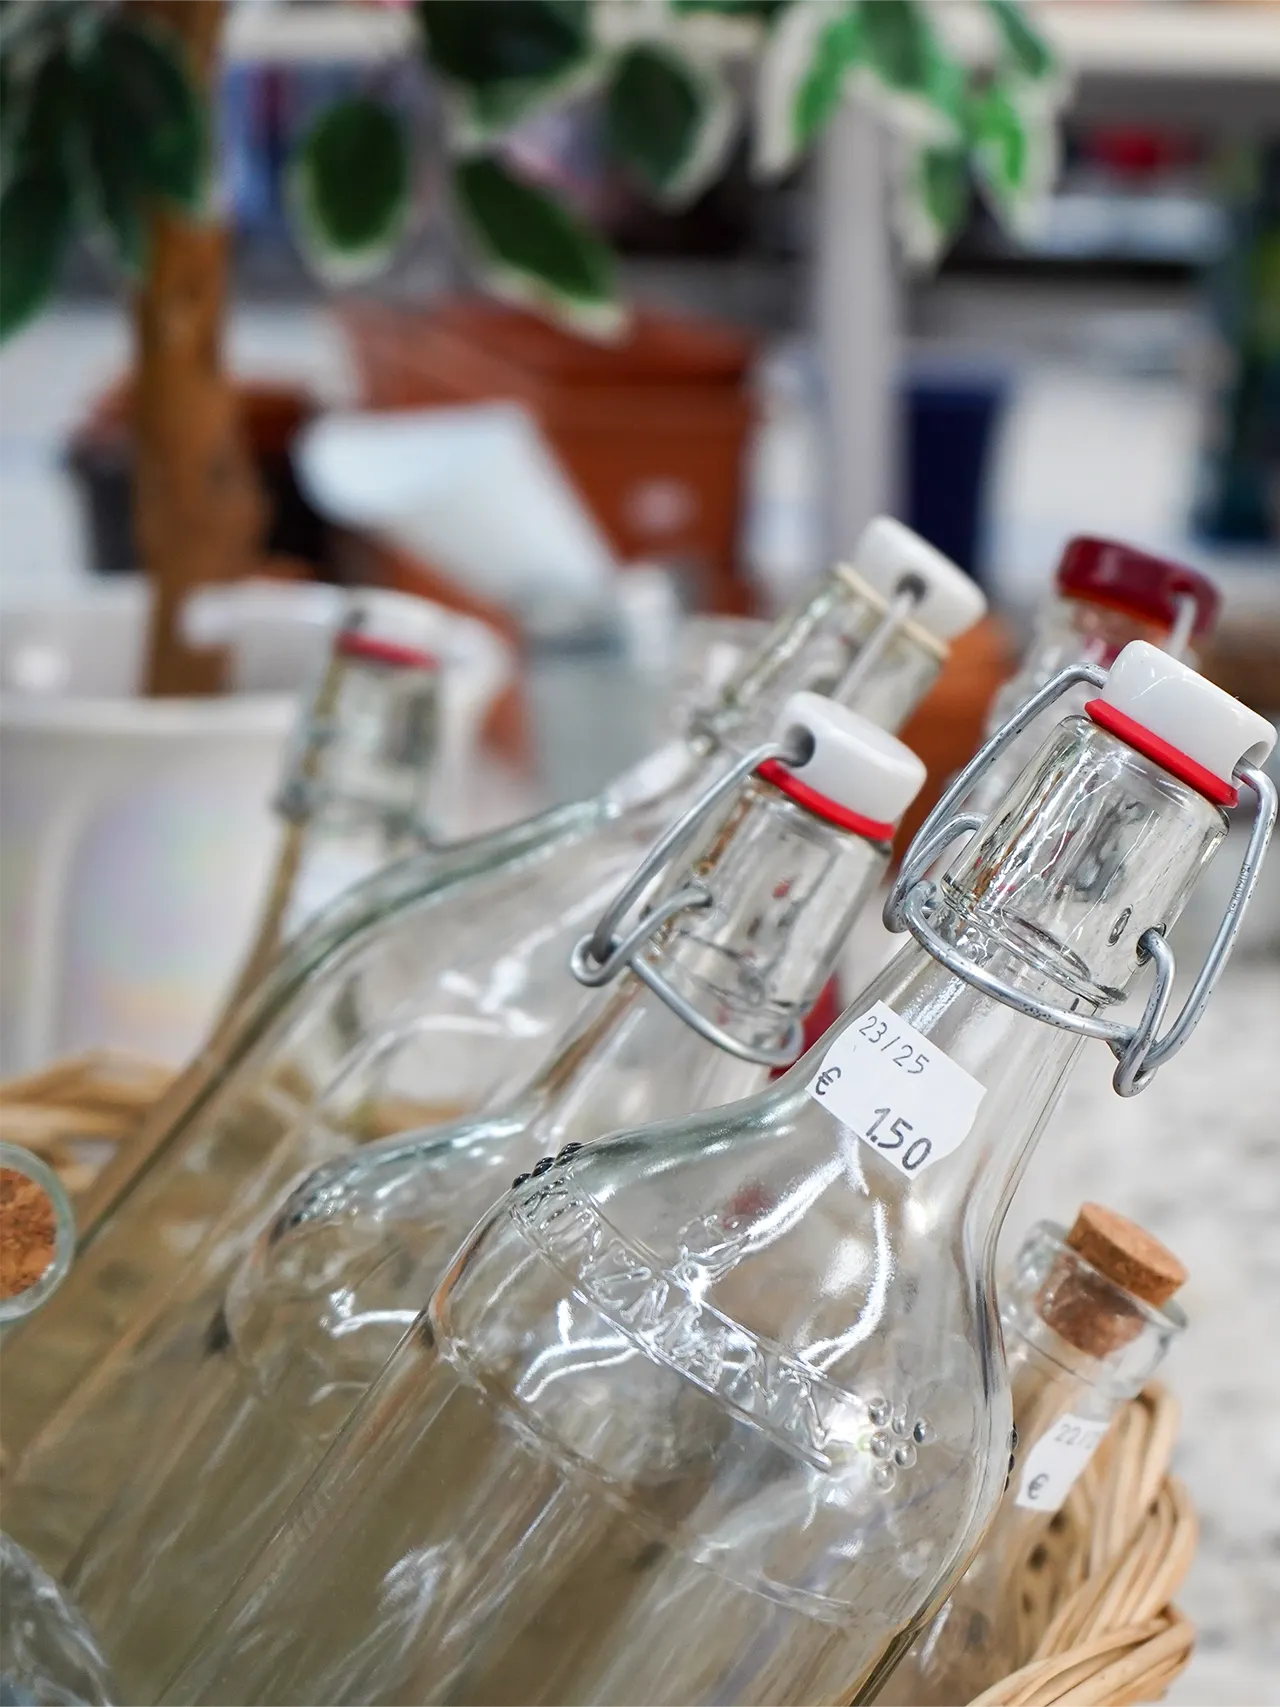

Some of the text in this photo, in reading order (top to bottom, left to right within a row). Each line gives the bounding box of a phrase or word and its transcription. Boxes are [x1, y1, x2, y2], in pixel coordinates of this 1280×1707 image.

[859, 1015, 930, 1074] 23/25
[815, 1066, 932, 1170] € 1.50
[1027, 1473, 1049, 1499] €
